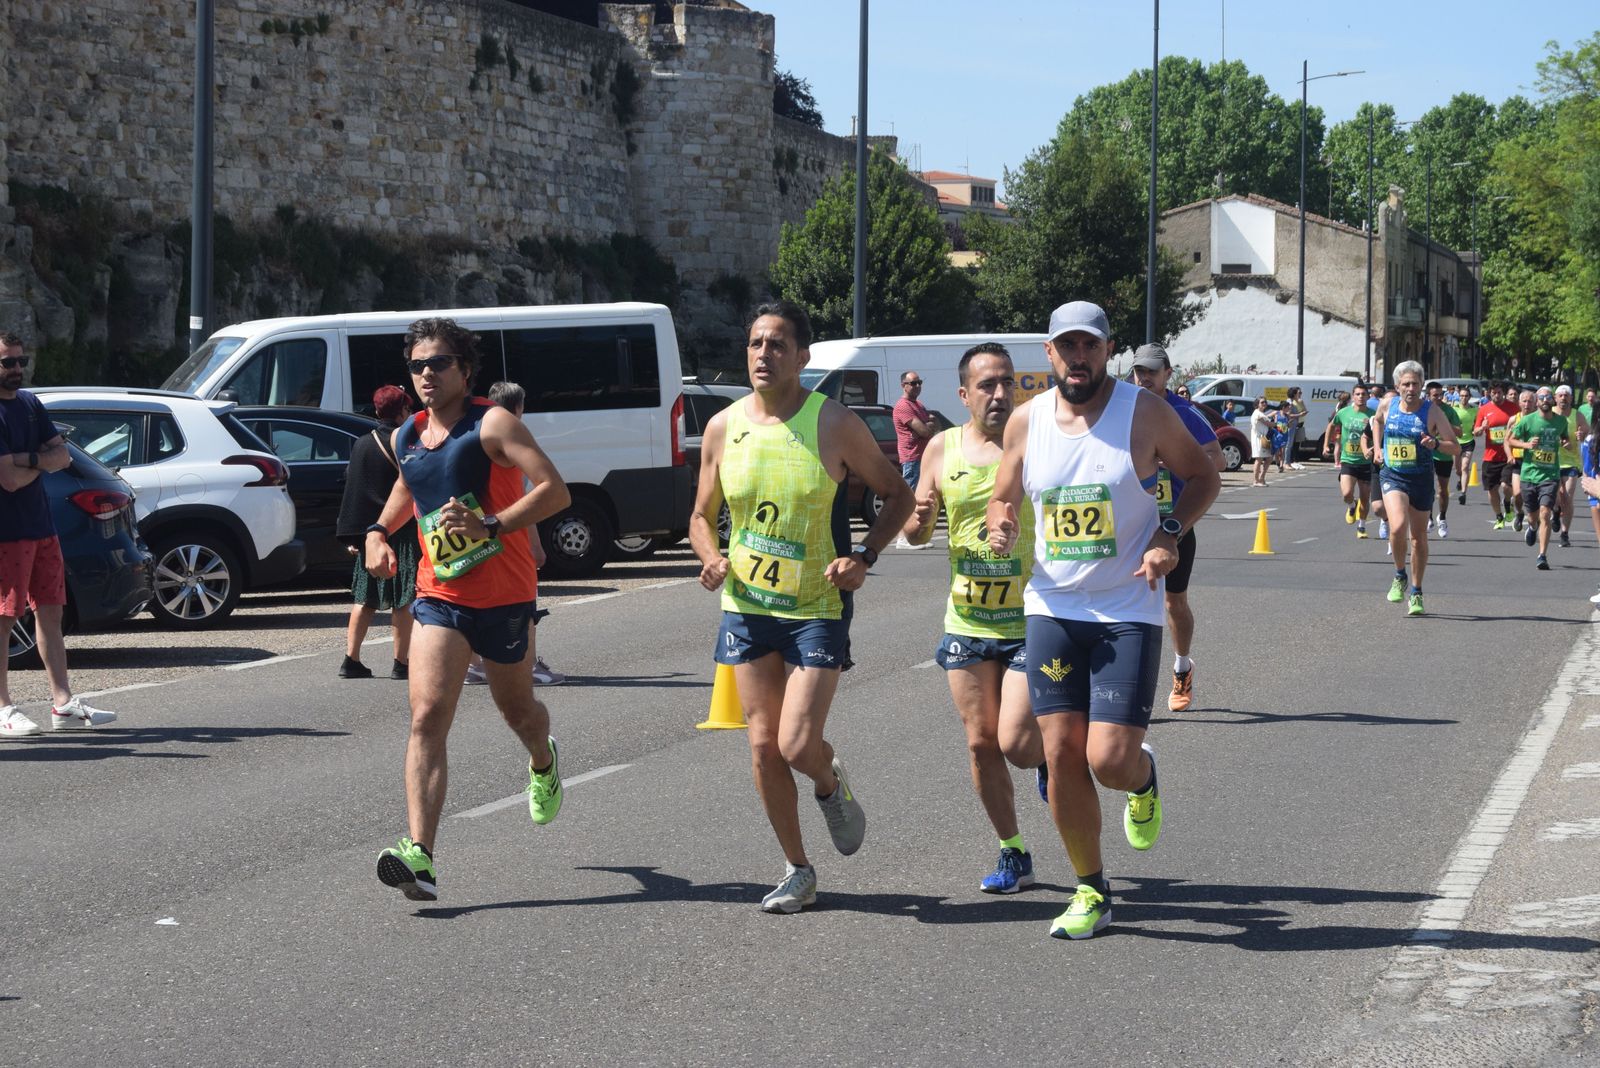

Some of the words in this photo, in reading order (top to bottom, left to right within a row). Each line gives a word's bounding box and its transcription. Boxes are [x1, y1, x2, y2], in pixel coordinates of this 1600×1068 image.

[1392, 446, 1408, 459] 46
[1074, 493, 1100, 502] RURAL
[1052, 507, 1103, 538] 132
[430, 529, 481, 562] 20
[754, 536, 797, 552] FUNDACION
[472, 544, 499, 561] RURAL
[770, 548, 795, 558] RURAL
[749, 554, 781, 588] 74
[971, 562, 1012, 570] FUNDACION
[963, 579, 1011, 605] 177
[764, 595, 793, 607] RURAL
[992, 610, 1020, 620] RURAL
